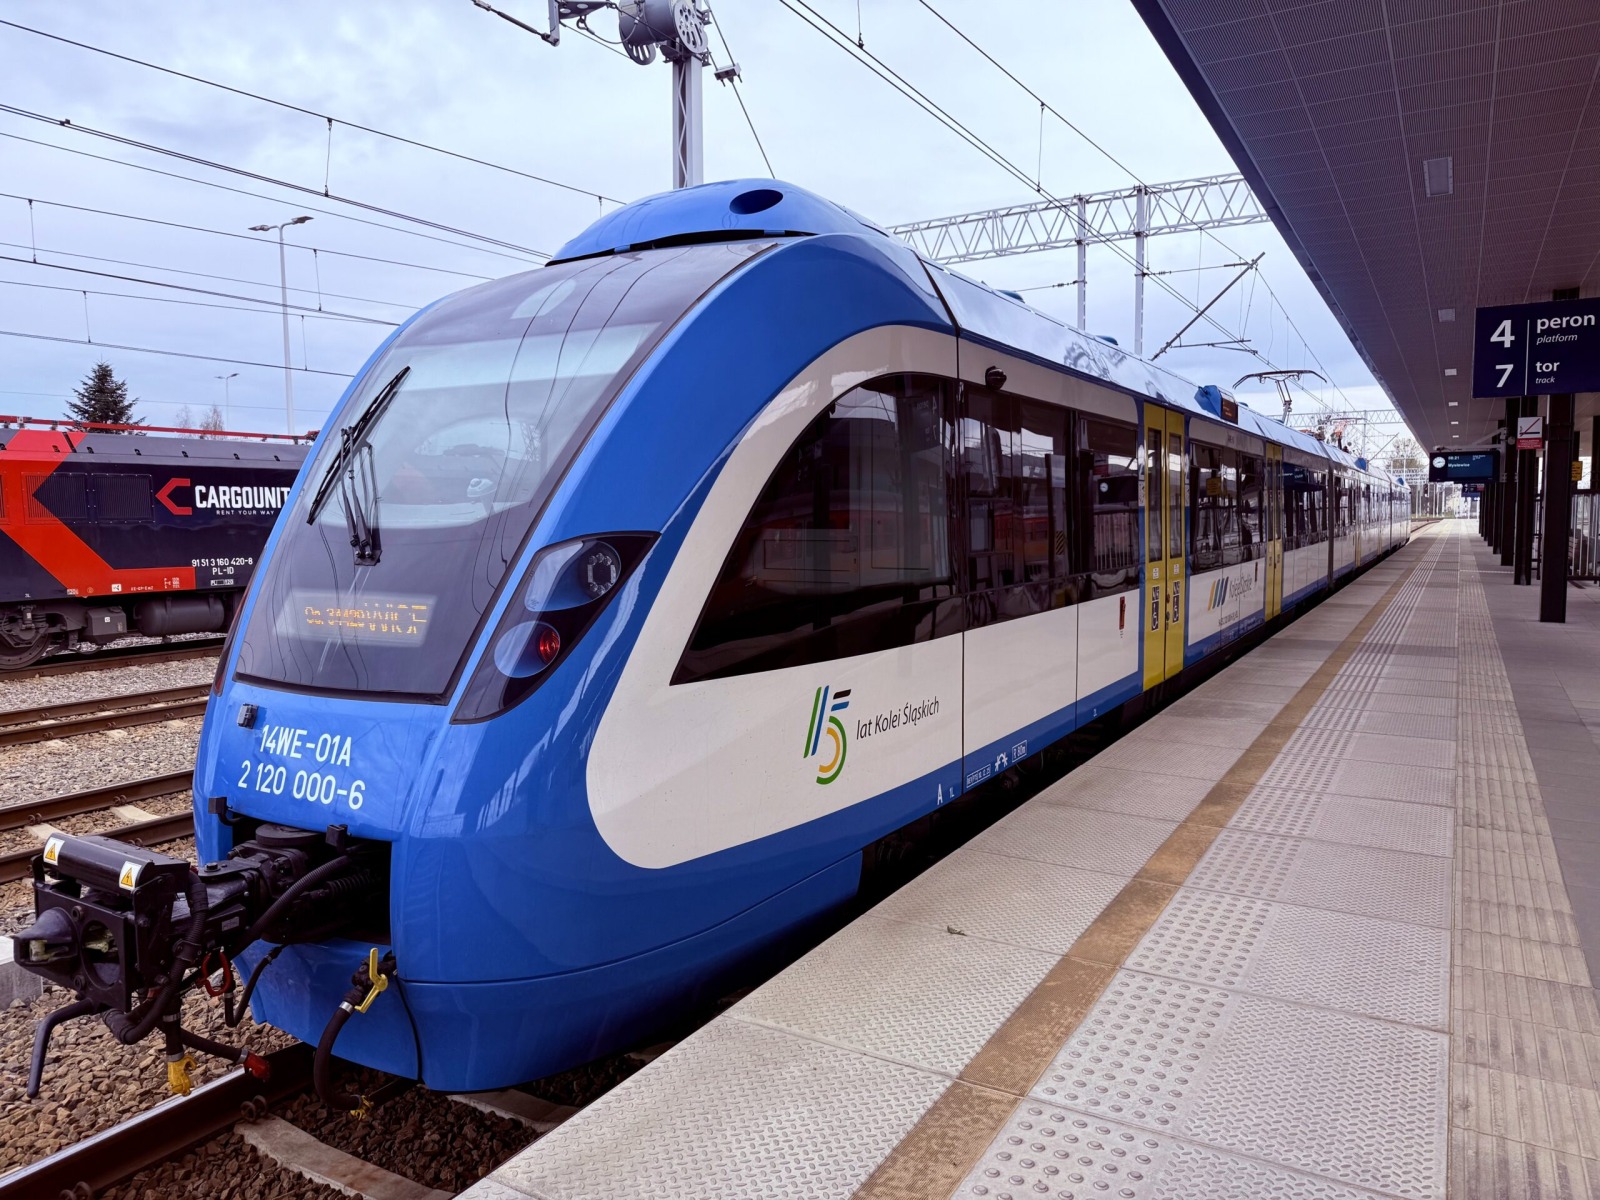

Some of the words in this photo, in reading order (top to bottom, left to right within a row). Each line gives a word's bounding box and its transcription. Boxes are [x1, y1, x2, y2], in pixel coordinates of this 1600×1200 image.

[1490, 319, 1515, 348] 4
[1536, 314, 1596, 333] peron
[1536, 333, 1578, 345] platform
[1495, 363, 1514, 388] 7
[1535, 360, 1560, 373] tor
[1535, 376, 1555, 384] track
[194, 485, 290, 509] CARGOUNIT
[191, 559, 200, 567] 91
[201, 558, 209, 567] 51
[210, 558, 216, 567] 3
[216, 558, 229, 566] 160
[230, 557, 253, 566] 420-8
[212, 566, 235, 575] PL-ID
[856, 718, 872, 740] lat
[874, 709, 901, 735] Kolei
[902, 695, 940, 727] Śląskich
[259, 724, 352, 767] 14WE-01A
[237, 760, 251, 788] 2
[255, 764, 287, 795] 120
[292, 769, 366, 810] 000-6
[937, 783, 944, 806] A
